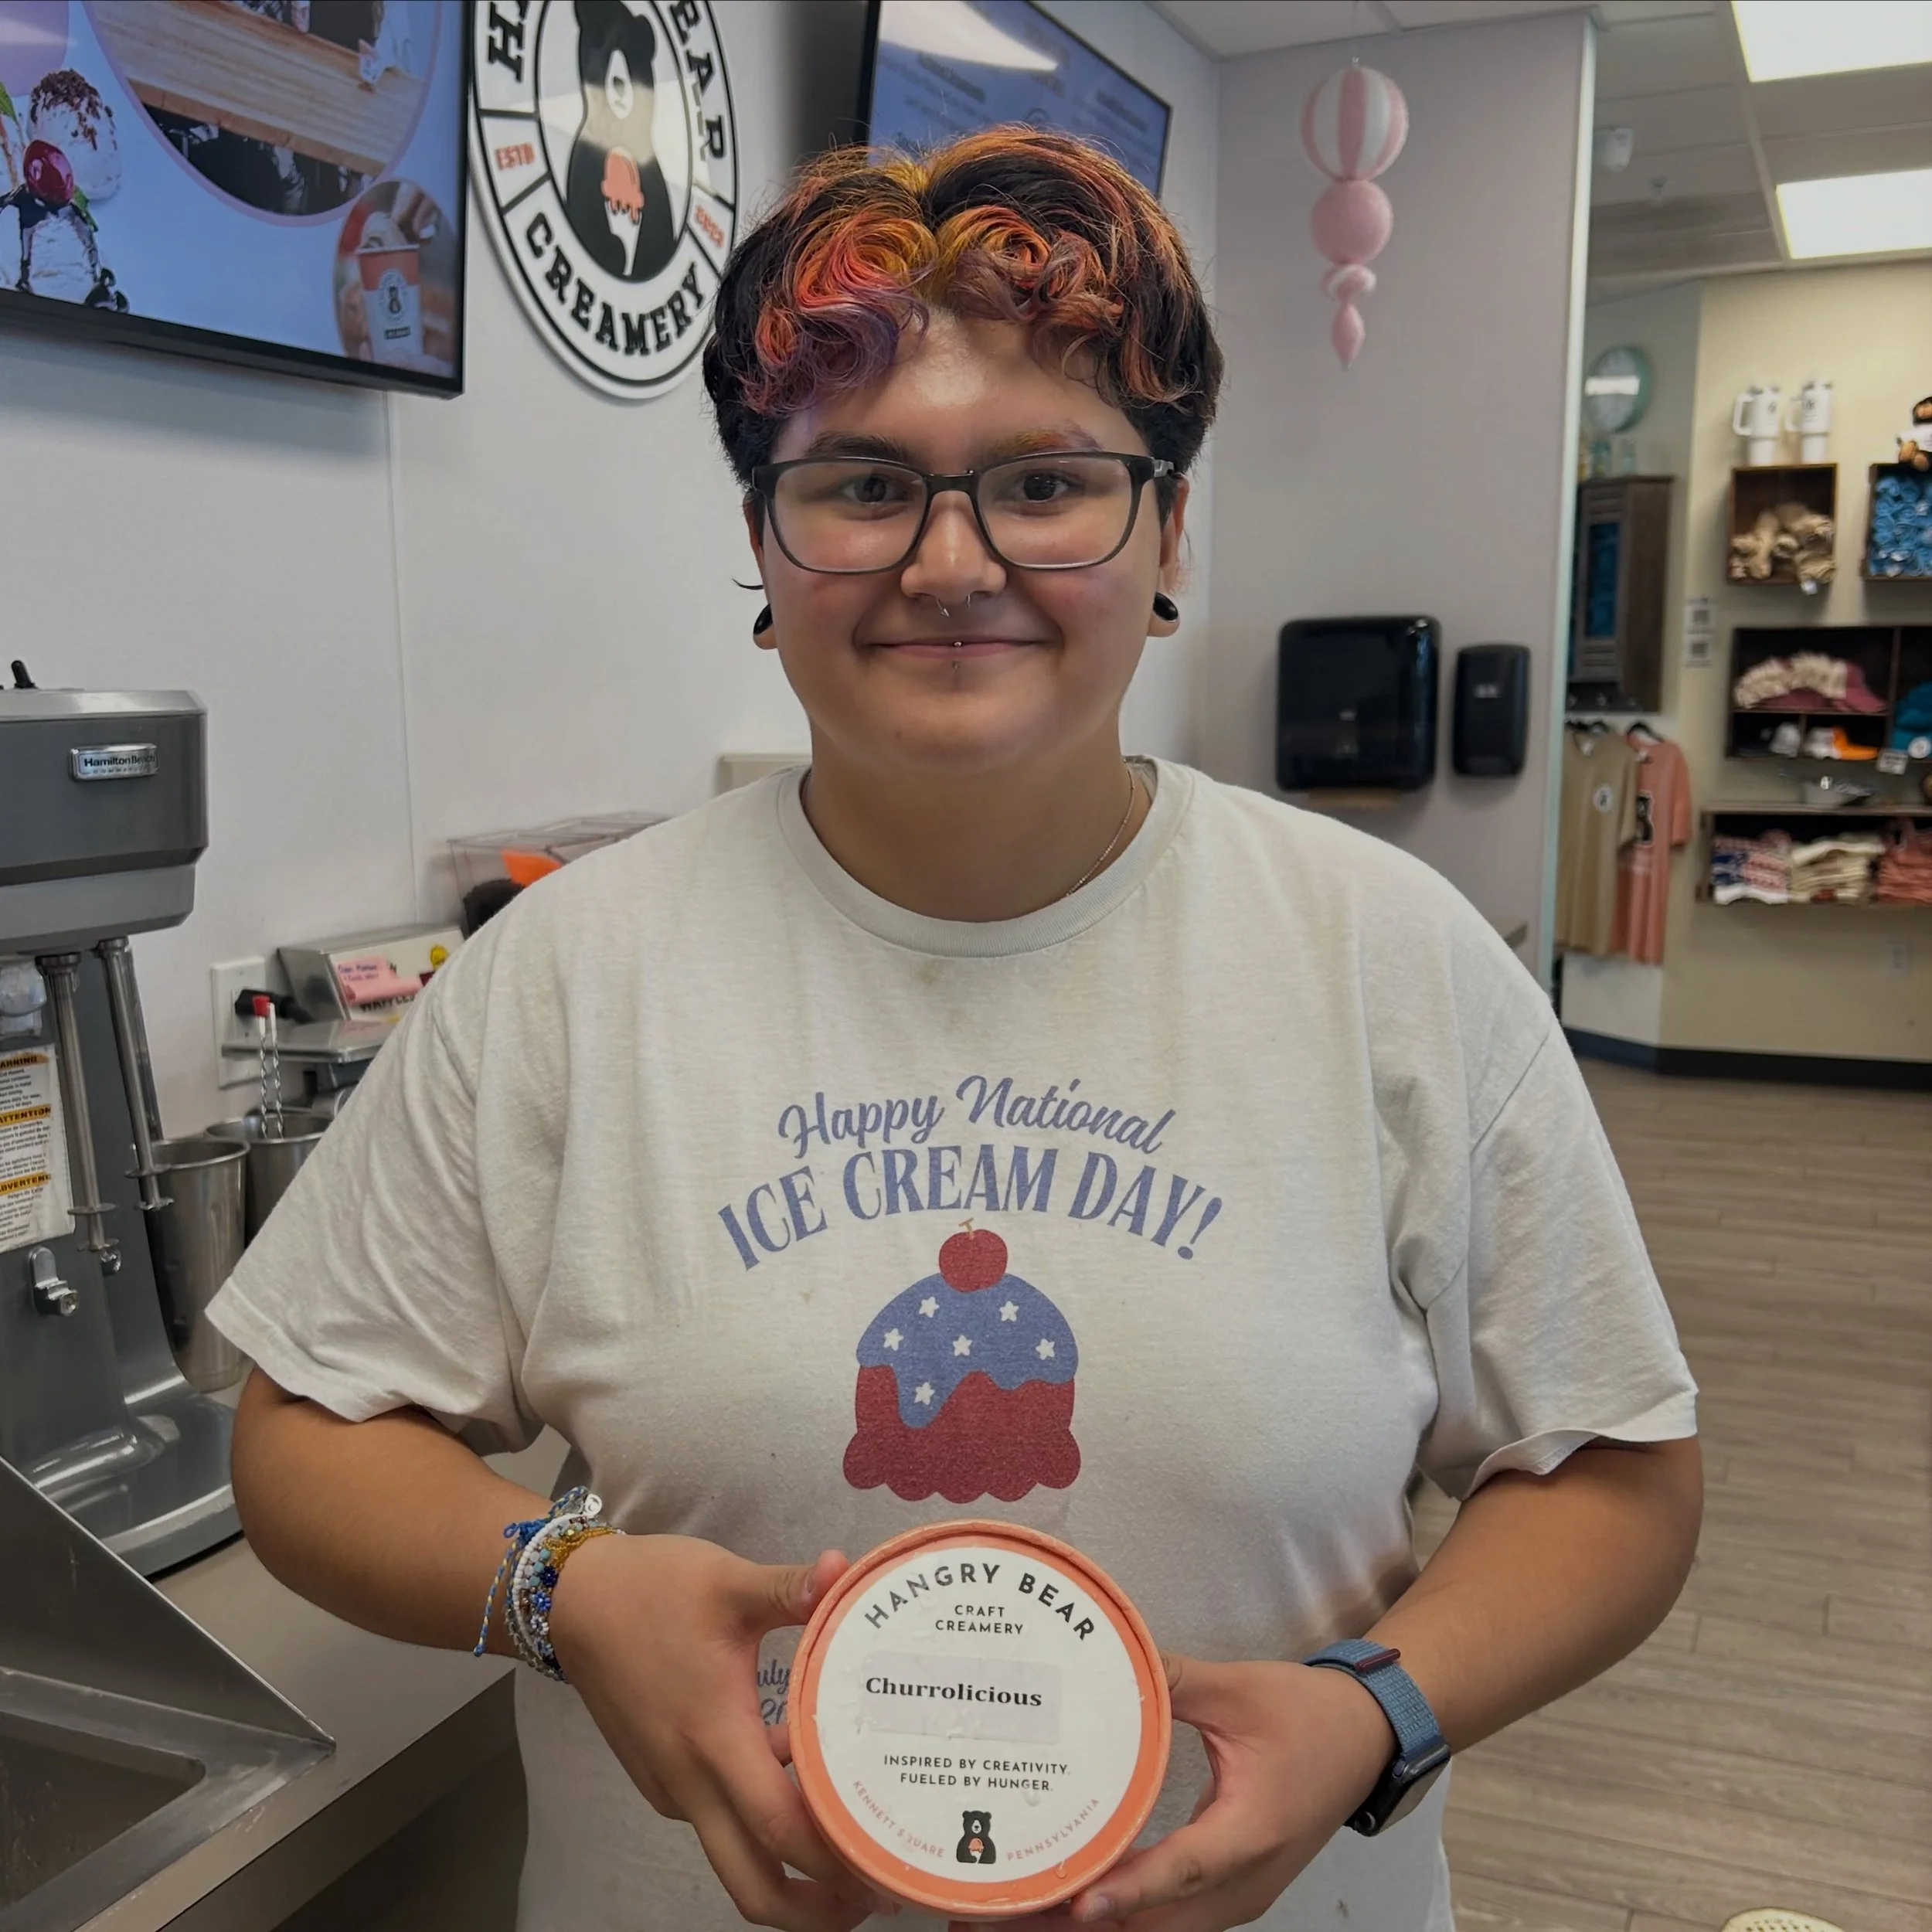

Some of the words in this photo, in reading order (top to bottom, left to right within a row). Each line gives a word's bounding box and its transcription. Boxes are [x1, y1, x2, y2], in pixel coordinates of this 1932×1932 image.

[526, 212, 705, 355] CREAMERY
[778, 1091, 944, 1158] Happy
[955, 1075, 1176, 1155] National
[717, 1165, 828, 1271] ICE
[842, 1144, 1059, 1220] CREAM
[1068, 1151, 1223, 1260] DAY!
[864, 1563, 1000, 1629] HANGRY
[1018, 1573, 1094, 1641] BEAR
[954, 1604, 1005, 1617] CRAFT
[935, 1620, 1024, 1634] CREAMERY
[757, 1658, 791, 1695] uly
[866, 1676, 1043, 1707] Churrolicious
[883, 1754, 953, 1768] INSPIRED
[959, 1759, 977, 1770] BY
[900, 1773, 957, 1786] FUELED
[964, 1777, 981, 1787] BY
[852, 1780, 896, 1831] KENNETT
[1006, 1798, 1100, 1862] PENNSYLVANIA
